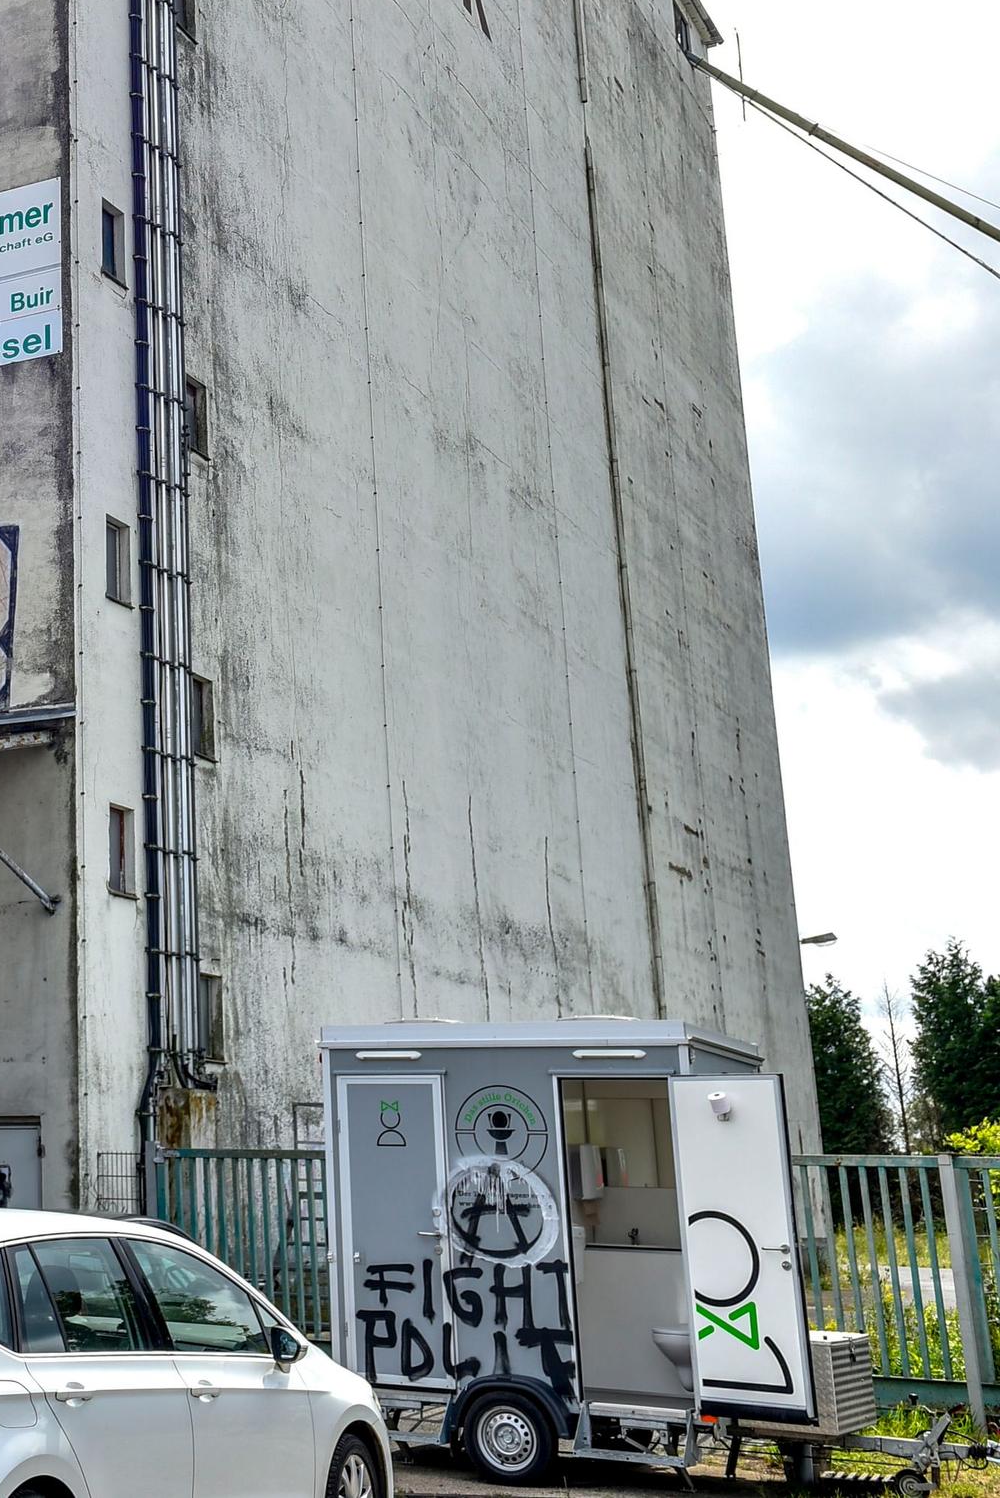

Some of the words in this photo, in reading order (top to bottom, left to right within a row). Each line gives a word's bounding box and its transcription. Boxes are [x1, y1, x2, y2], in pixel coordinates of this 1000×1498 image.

[34, 231, 54, 244] eG
[10, 287, 54, 312] Buir
[363, 1258, 571, 1330] FIGHT
